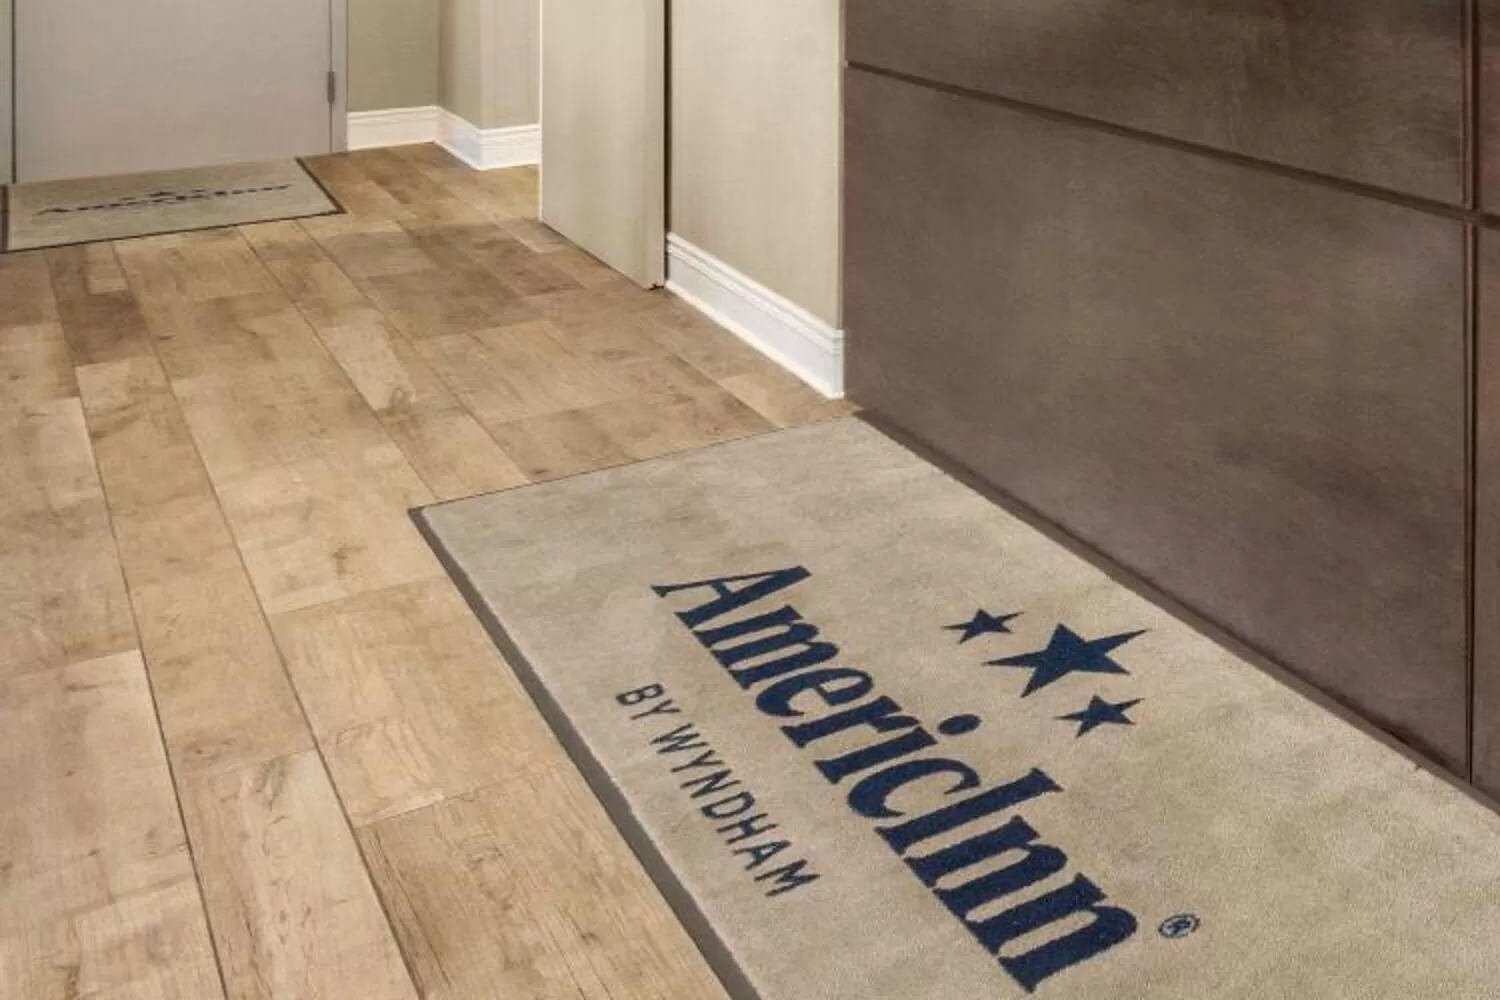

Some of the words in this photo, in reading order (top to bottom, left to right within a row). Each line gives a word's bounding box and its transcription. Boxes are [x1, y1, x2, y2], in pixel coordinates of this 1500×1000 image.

[615, 682, 682, 720] BY
[650, 565, 1139, 995] AmericInn
[648, 722, 822, 897] WYNDHAM
